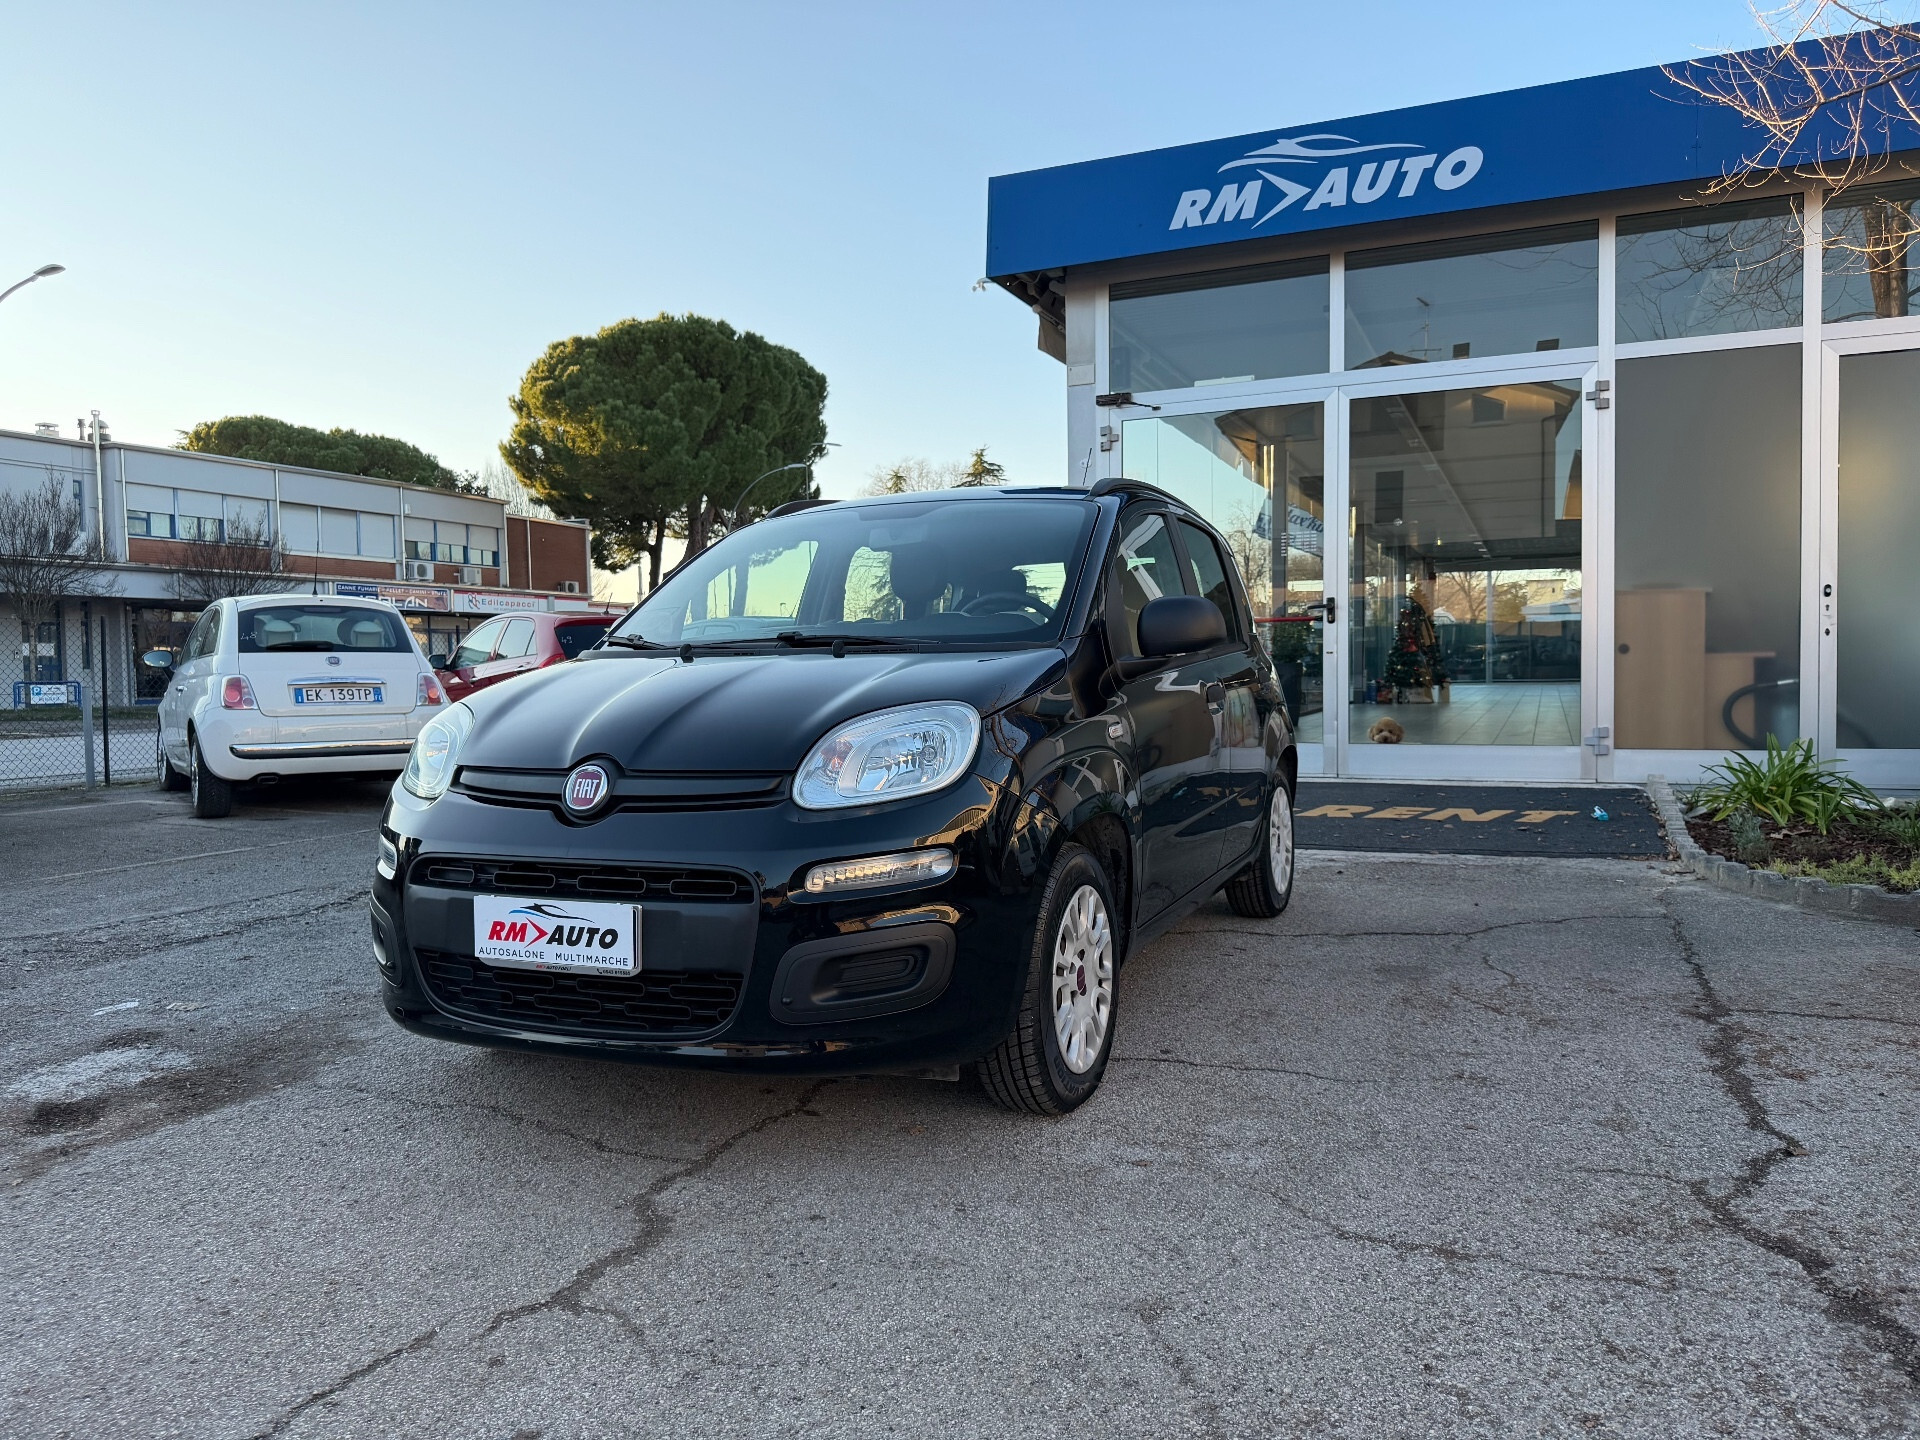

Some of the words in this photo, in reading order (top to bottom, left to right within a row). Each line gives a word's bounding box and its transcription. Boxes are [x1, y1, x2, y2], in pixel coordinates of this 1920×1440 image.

[1168, 179, 1263, 231] RM
[1302, 145, 1484, 211] AUTO
[481, 598, 535, 608] Edilcapacci
[305, 688, 323, 702] EK
[330, 688, 372, 701] 139TP
[573, 778, 600, 799] FIAT
[1295, 804, 1580, 823] RENT
[488, 920, 528, 943] RM
[545, 924, 619, 950] AUTO
[478, 946, 545, 960] AUTOSALONE
[555, 952, 629, 967] MULTIMARCHE
